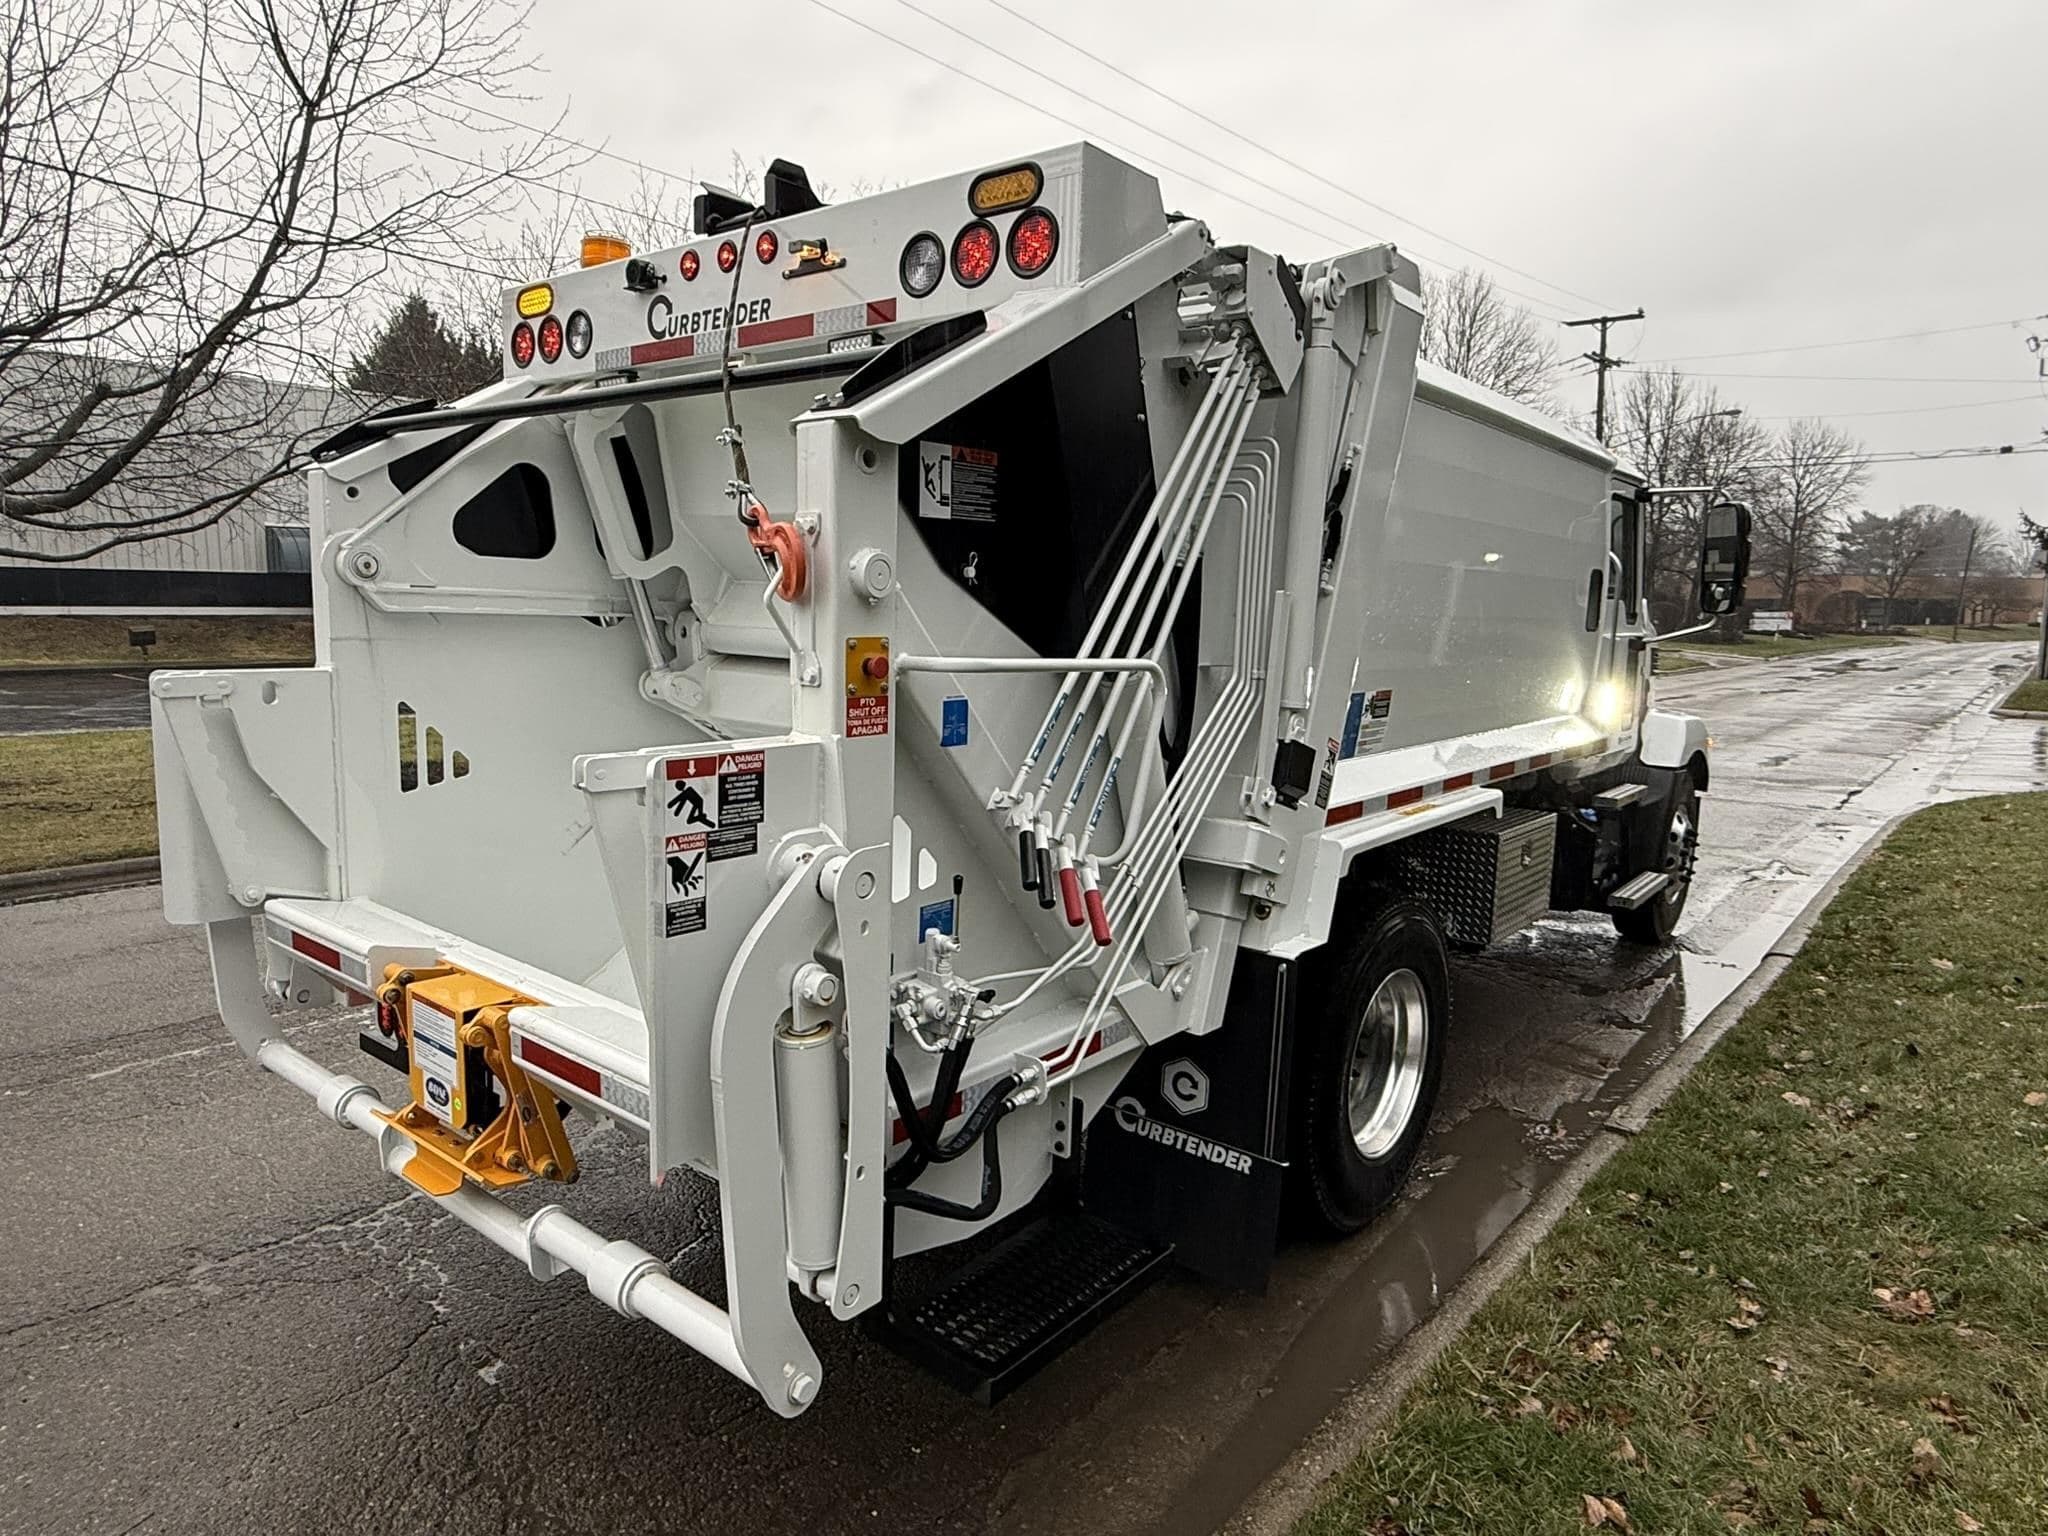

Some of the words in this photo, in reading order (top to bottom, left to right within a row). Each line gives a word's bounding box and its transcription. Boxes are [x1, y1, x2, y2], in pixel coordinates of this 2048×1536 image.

[648, 294, 771, 340] CURBTENDER
[860, 697, 876, 706] PTO
[849, 707, 870, 717] SHUT
[871, 706, 886, 716] OFF
[852, 724, 884, 735] APAGAR
[735, 753, 764, 763] DANGER
[737, 761, 762, 769] PELIGRO
[679, 833, 706, 842] DANGER
[680, 840, 705, 849] PELIGRO
[1115, 1096, 1252, 1175] CURBTENDER
